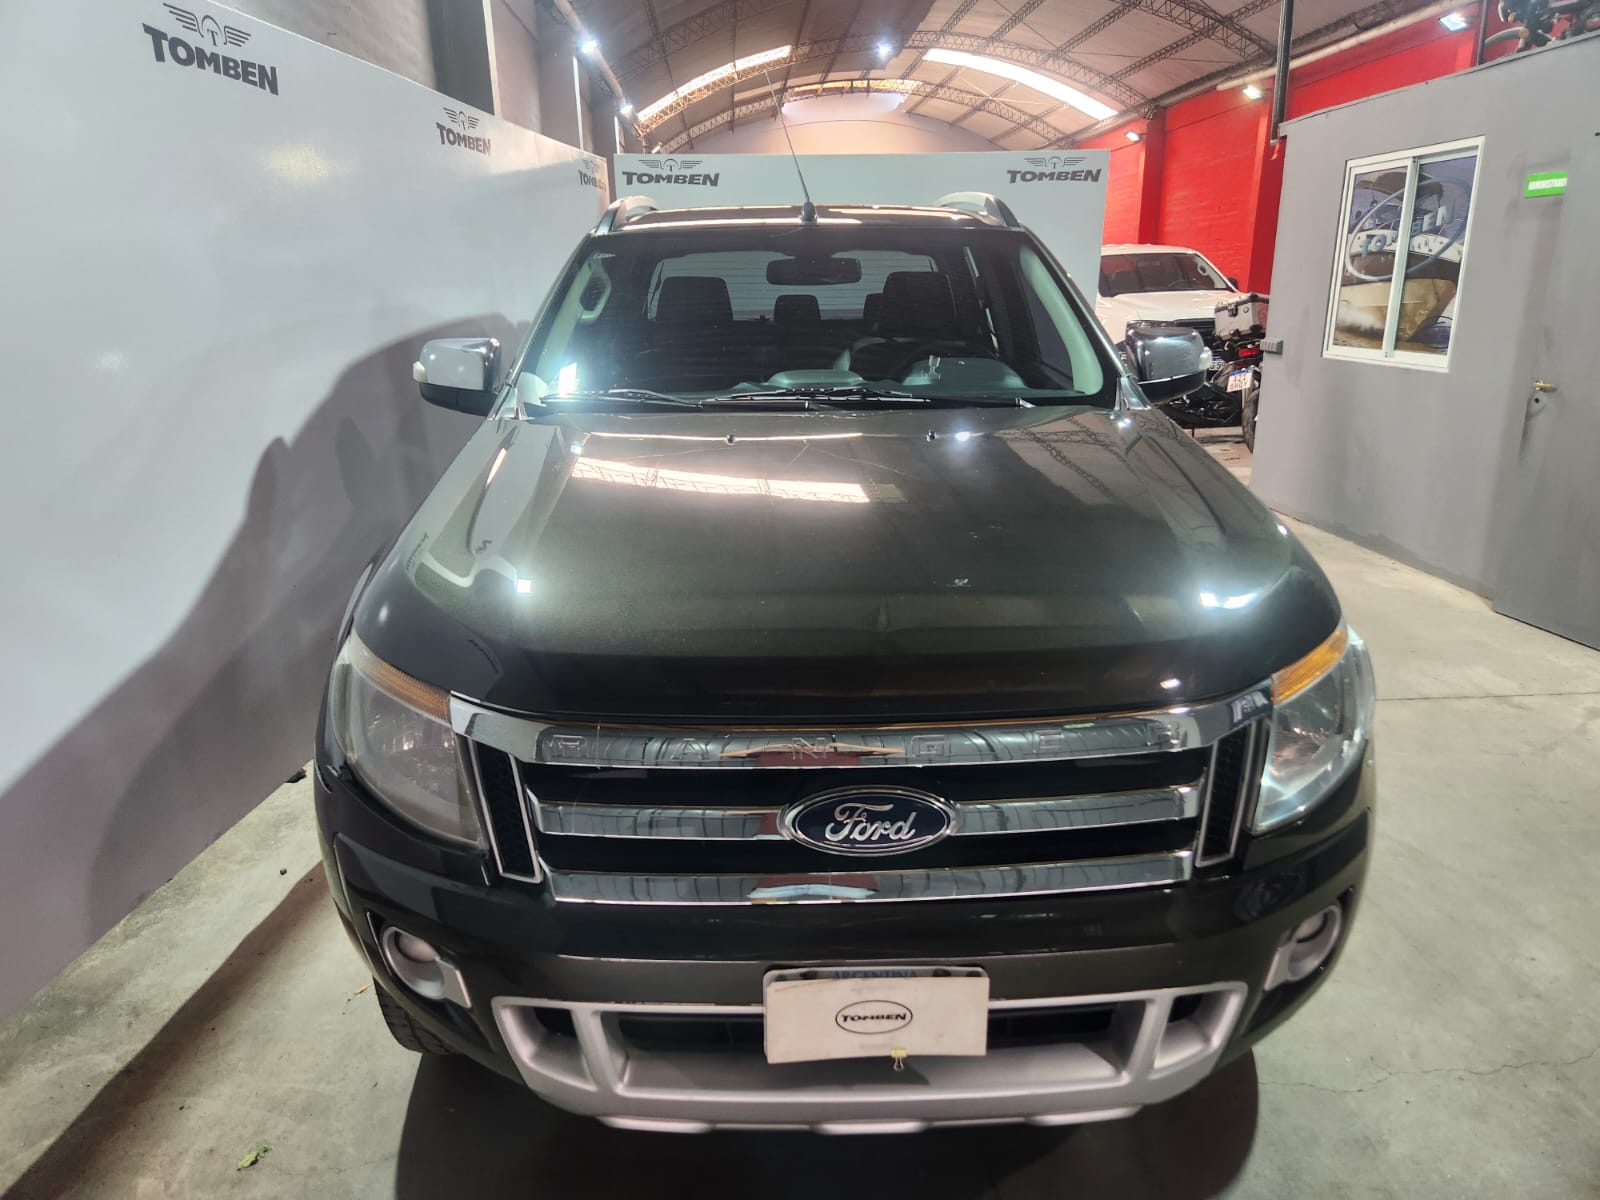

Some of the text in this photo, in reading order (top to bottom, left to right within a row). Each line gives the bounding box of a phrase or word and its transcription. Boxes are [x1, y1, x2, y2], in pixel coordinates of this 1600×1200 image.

[142, 23, 279, 95] TOMBEN
[436, 122, 490, 155] TOMBEN
[622, 171, 720, 187] TOMBEN
[1006, 168, 1102, 184] TOMBEN
[824, 802, 917, 842] Ford
[841, 1012, 907, 1023] TOMBEN
